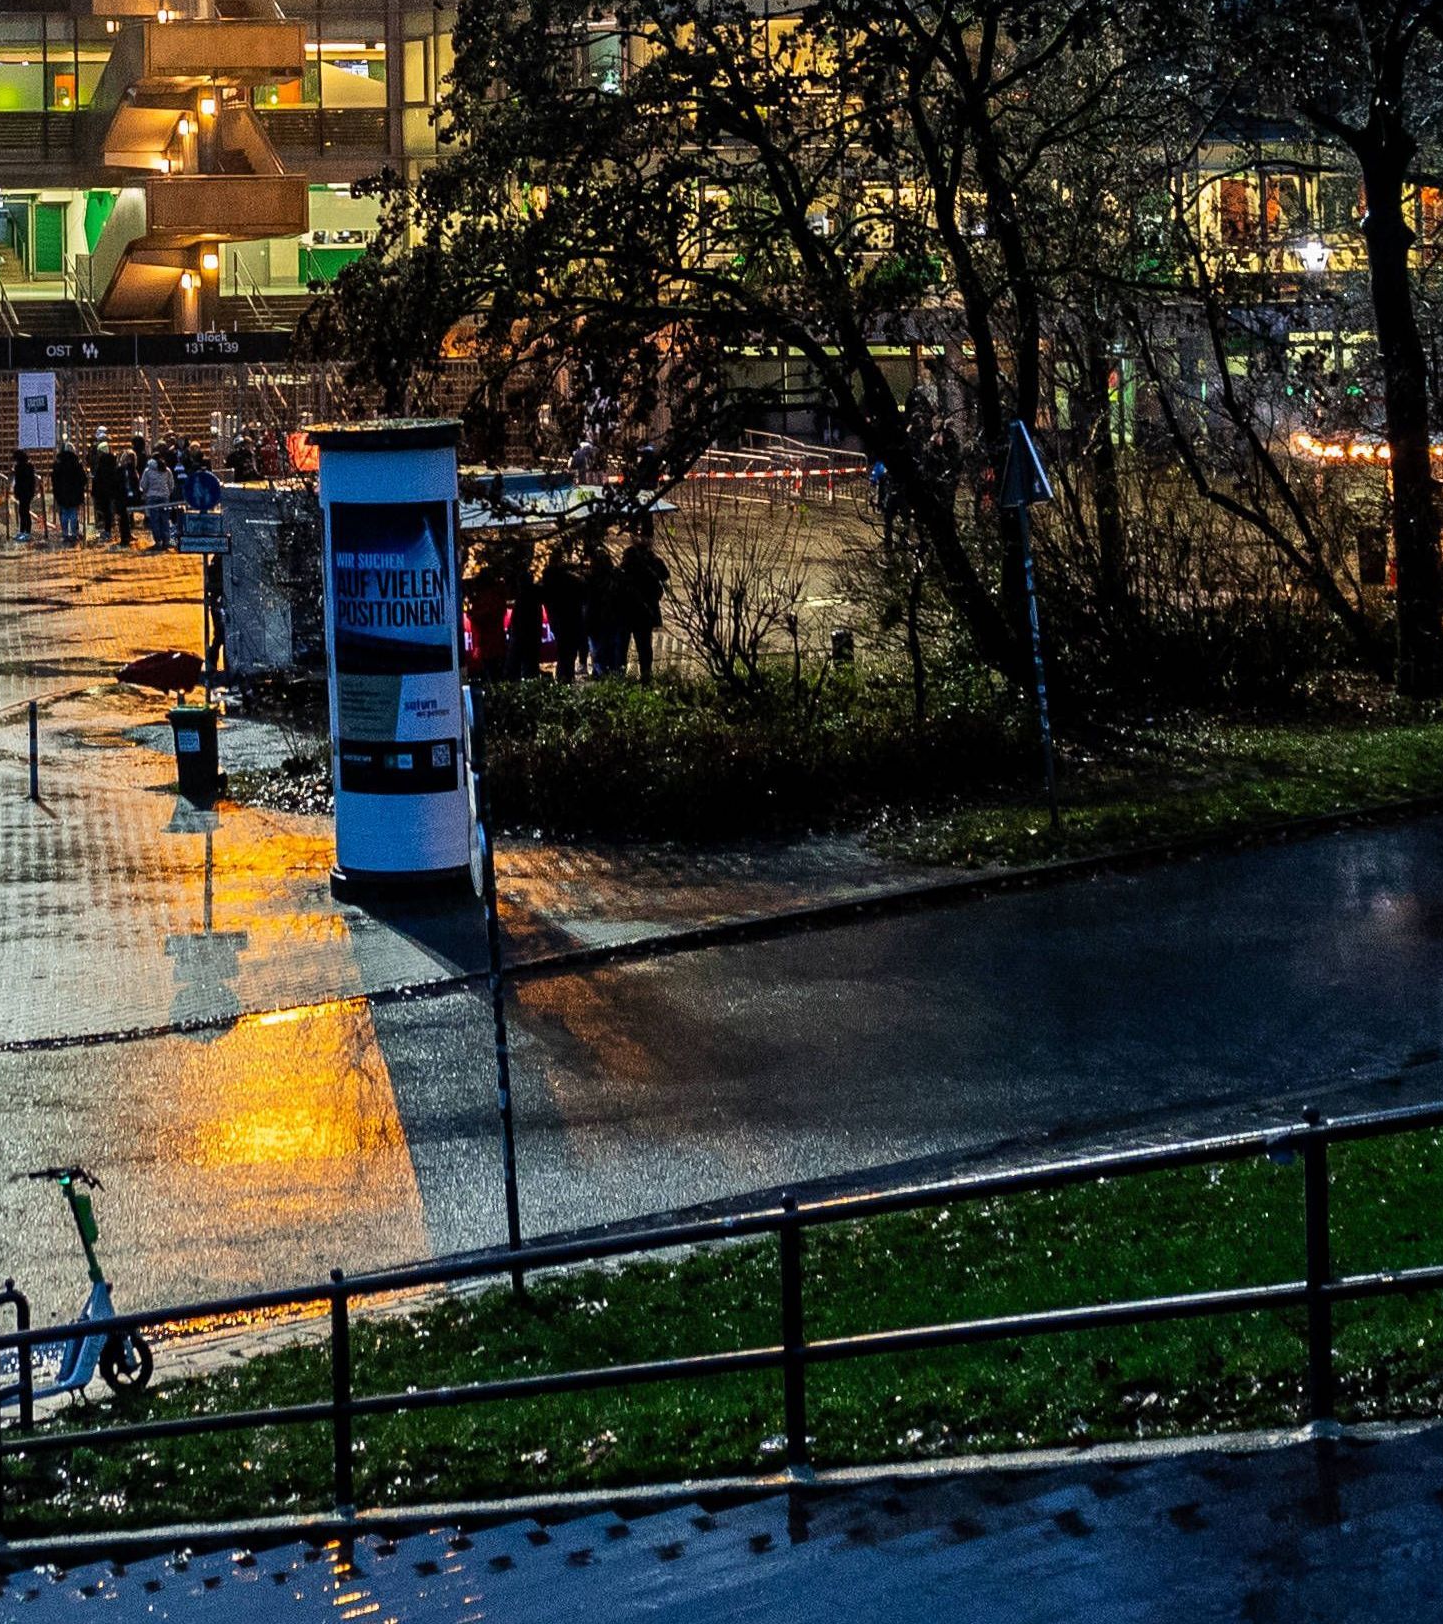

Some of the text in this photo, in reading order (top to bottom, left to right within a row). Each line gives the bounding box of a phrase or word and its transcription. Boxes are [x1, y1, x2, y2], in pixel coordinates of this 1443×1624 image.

[196, 331, 227, 342] Block
[46, 345, 73, 357] OST
[185, 342, 204, 354] 131
[218, 341, 239, 353] 139
[336, 552, 405, 569] WIR SUCHEN
[337, 568, 445, 599] AUF VIELEN
[337, 597, 446, 628] POSITIONEN!
